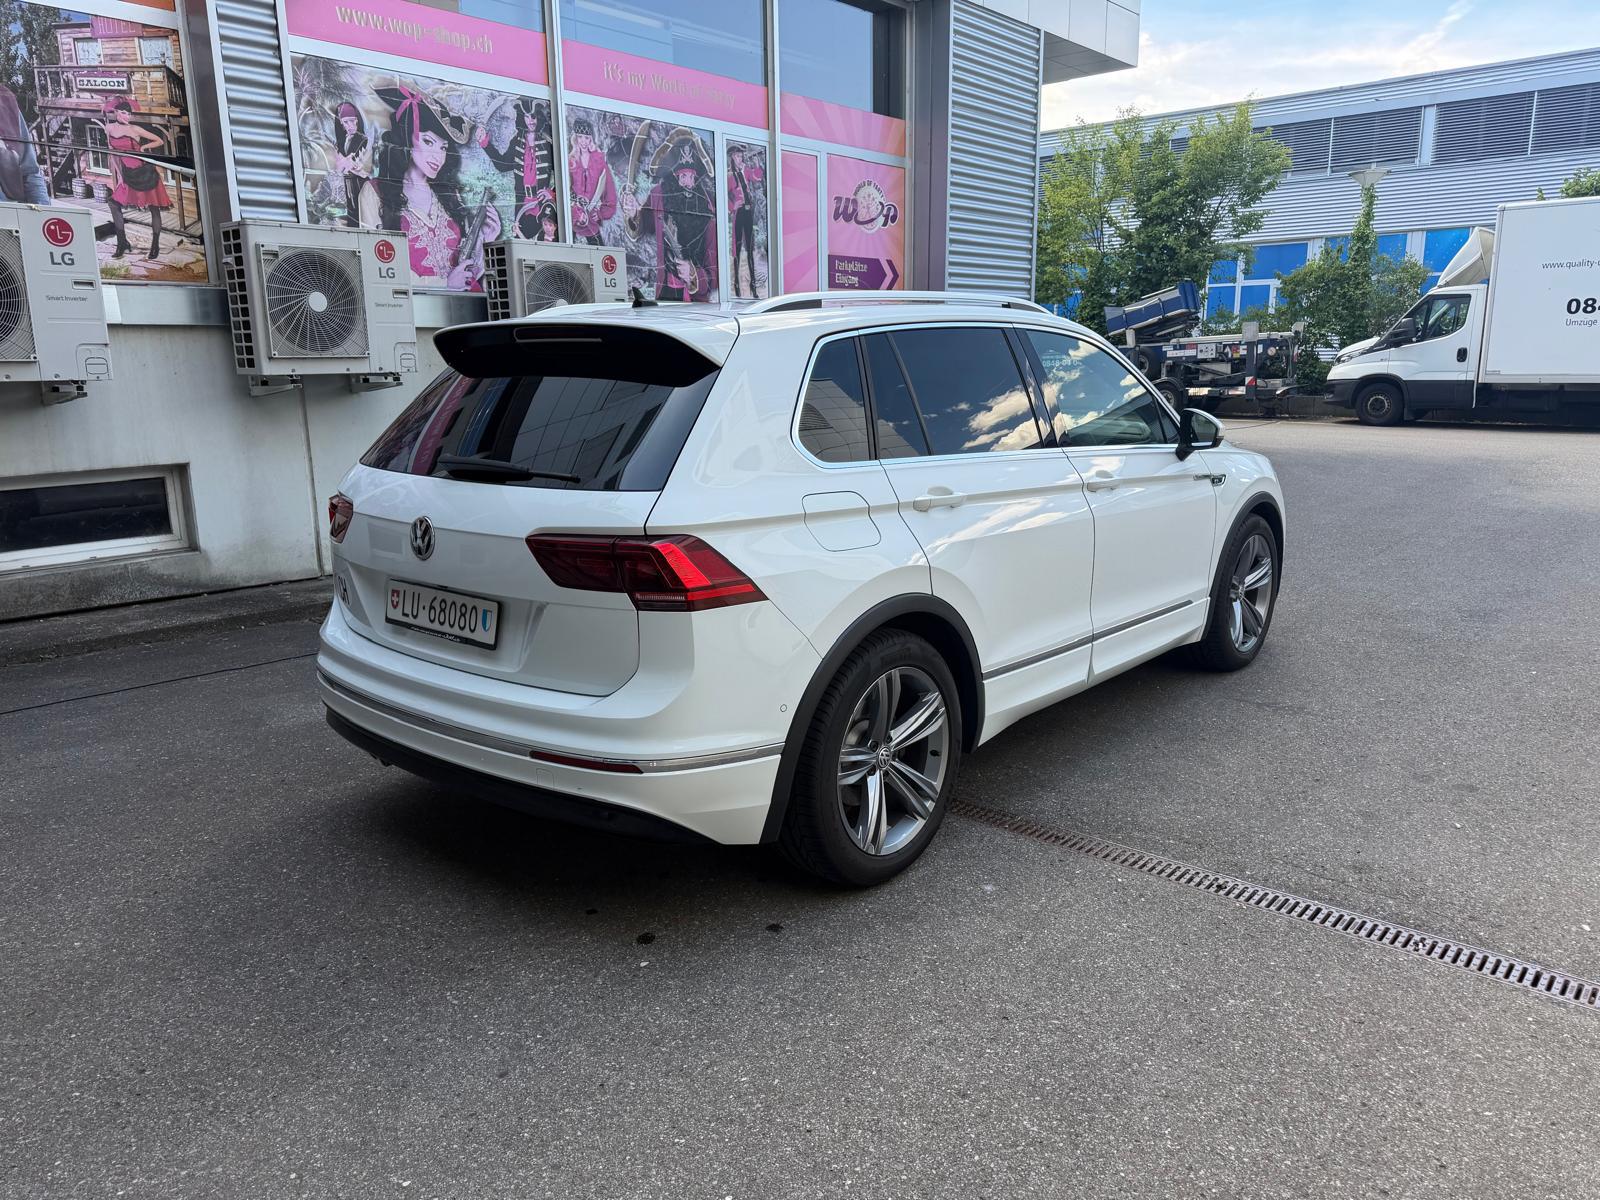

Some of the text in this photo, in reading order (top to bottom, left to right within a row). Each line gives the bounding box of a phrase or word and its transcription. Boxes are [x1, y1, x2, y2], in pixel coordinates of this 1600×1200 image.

[78, 79, 126, 88] SALOON
[49, 251, 75, 266] LG
[378, 267, 396, 279] LG
[604, 277, 617, 288] LG
[46, 294, 64, 302] Smart
[1566, 297, 1600, 315] 08
